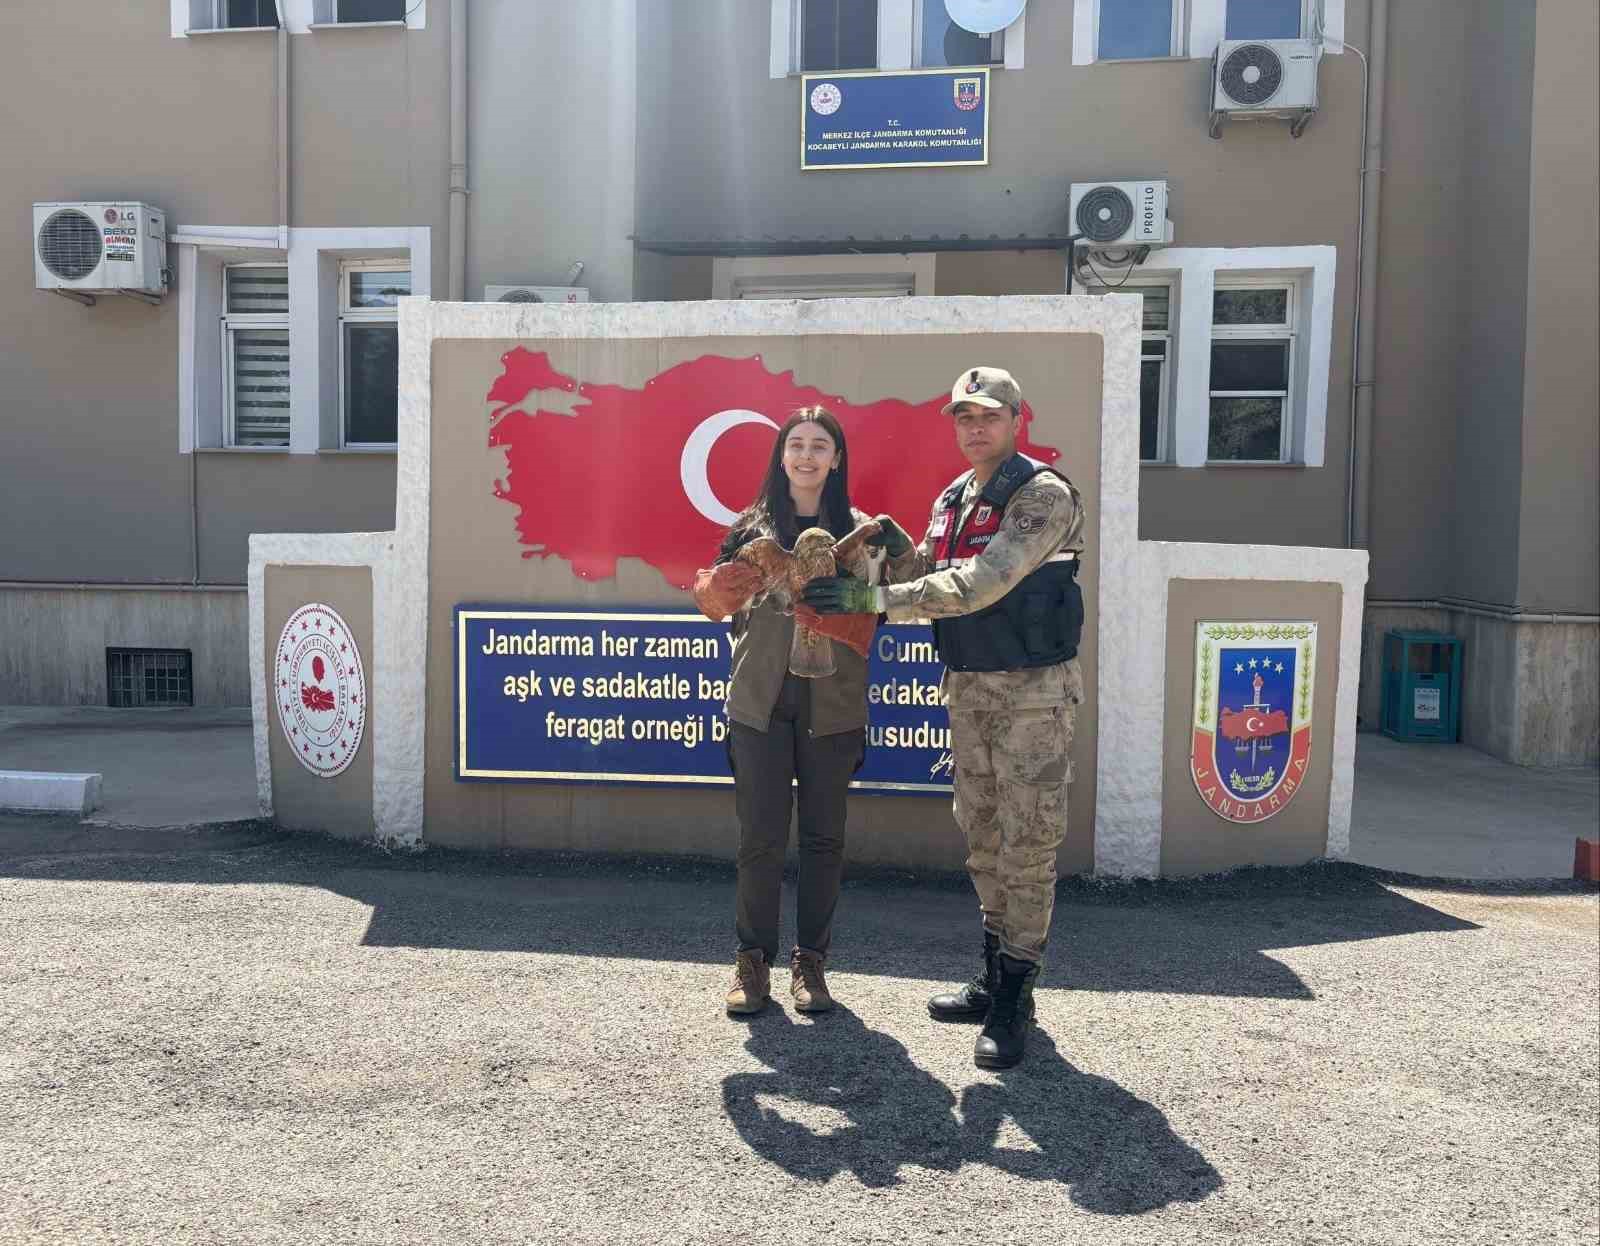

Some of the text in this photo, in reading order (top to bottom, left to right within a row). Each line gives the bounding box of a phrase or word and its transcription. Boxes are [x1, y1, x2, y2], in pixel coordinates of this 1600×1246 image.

[822, 127, 967, 140] MERKEZ İLÇE JANDARMA KOMUTANLIĞI
[887, 119, 901, 127] T.C.
[808, 137, 982, 151] KOCABEYLİ JANDARMA KARAKOL KOMUTANLIĞI
[120, 211, 135, 221] LG
[104, 227, 137, 236] BEKO
[481, 627, 594, 657] Jandarma
[601, 629, 639, 657] her
[643, 636, 719, 659] zaman
[878, 634, 940, 664] Cum
[503, 669, 543, 703] aşk
[548, 676, 576, 698] ve
[581, 671, 691, 700] sadakatle
[868, 677, 949, 706] edaka
[545, 711, 626, 746] feragat
[631, 713, 704, 749] orneği
[1196, 757, 1306, 819] JANDARMA
